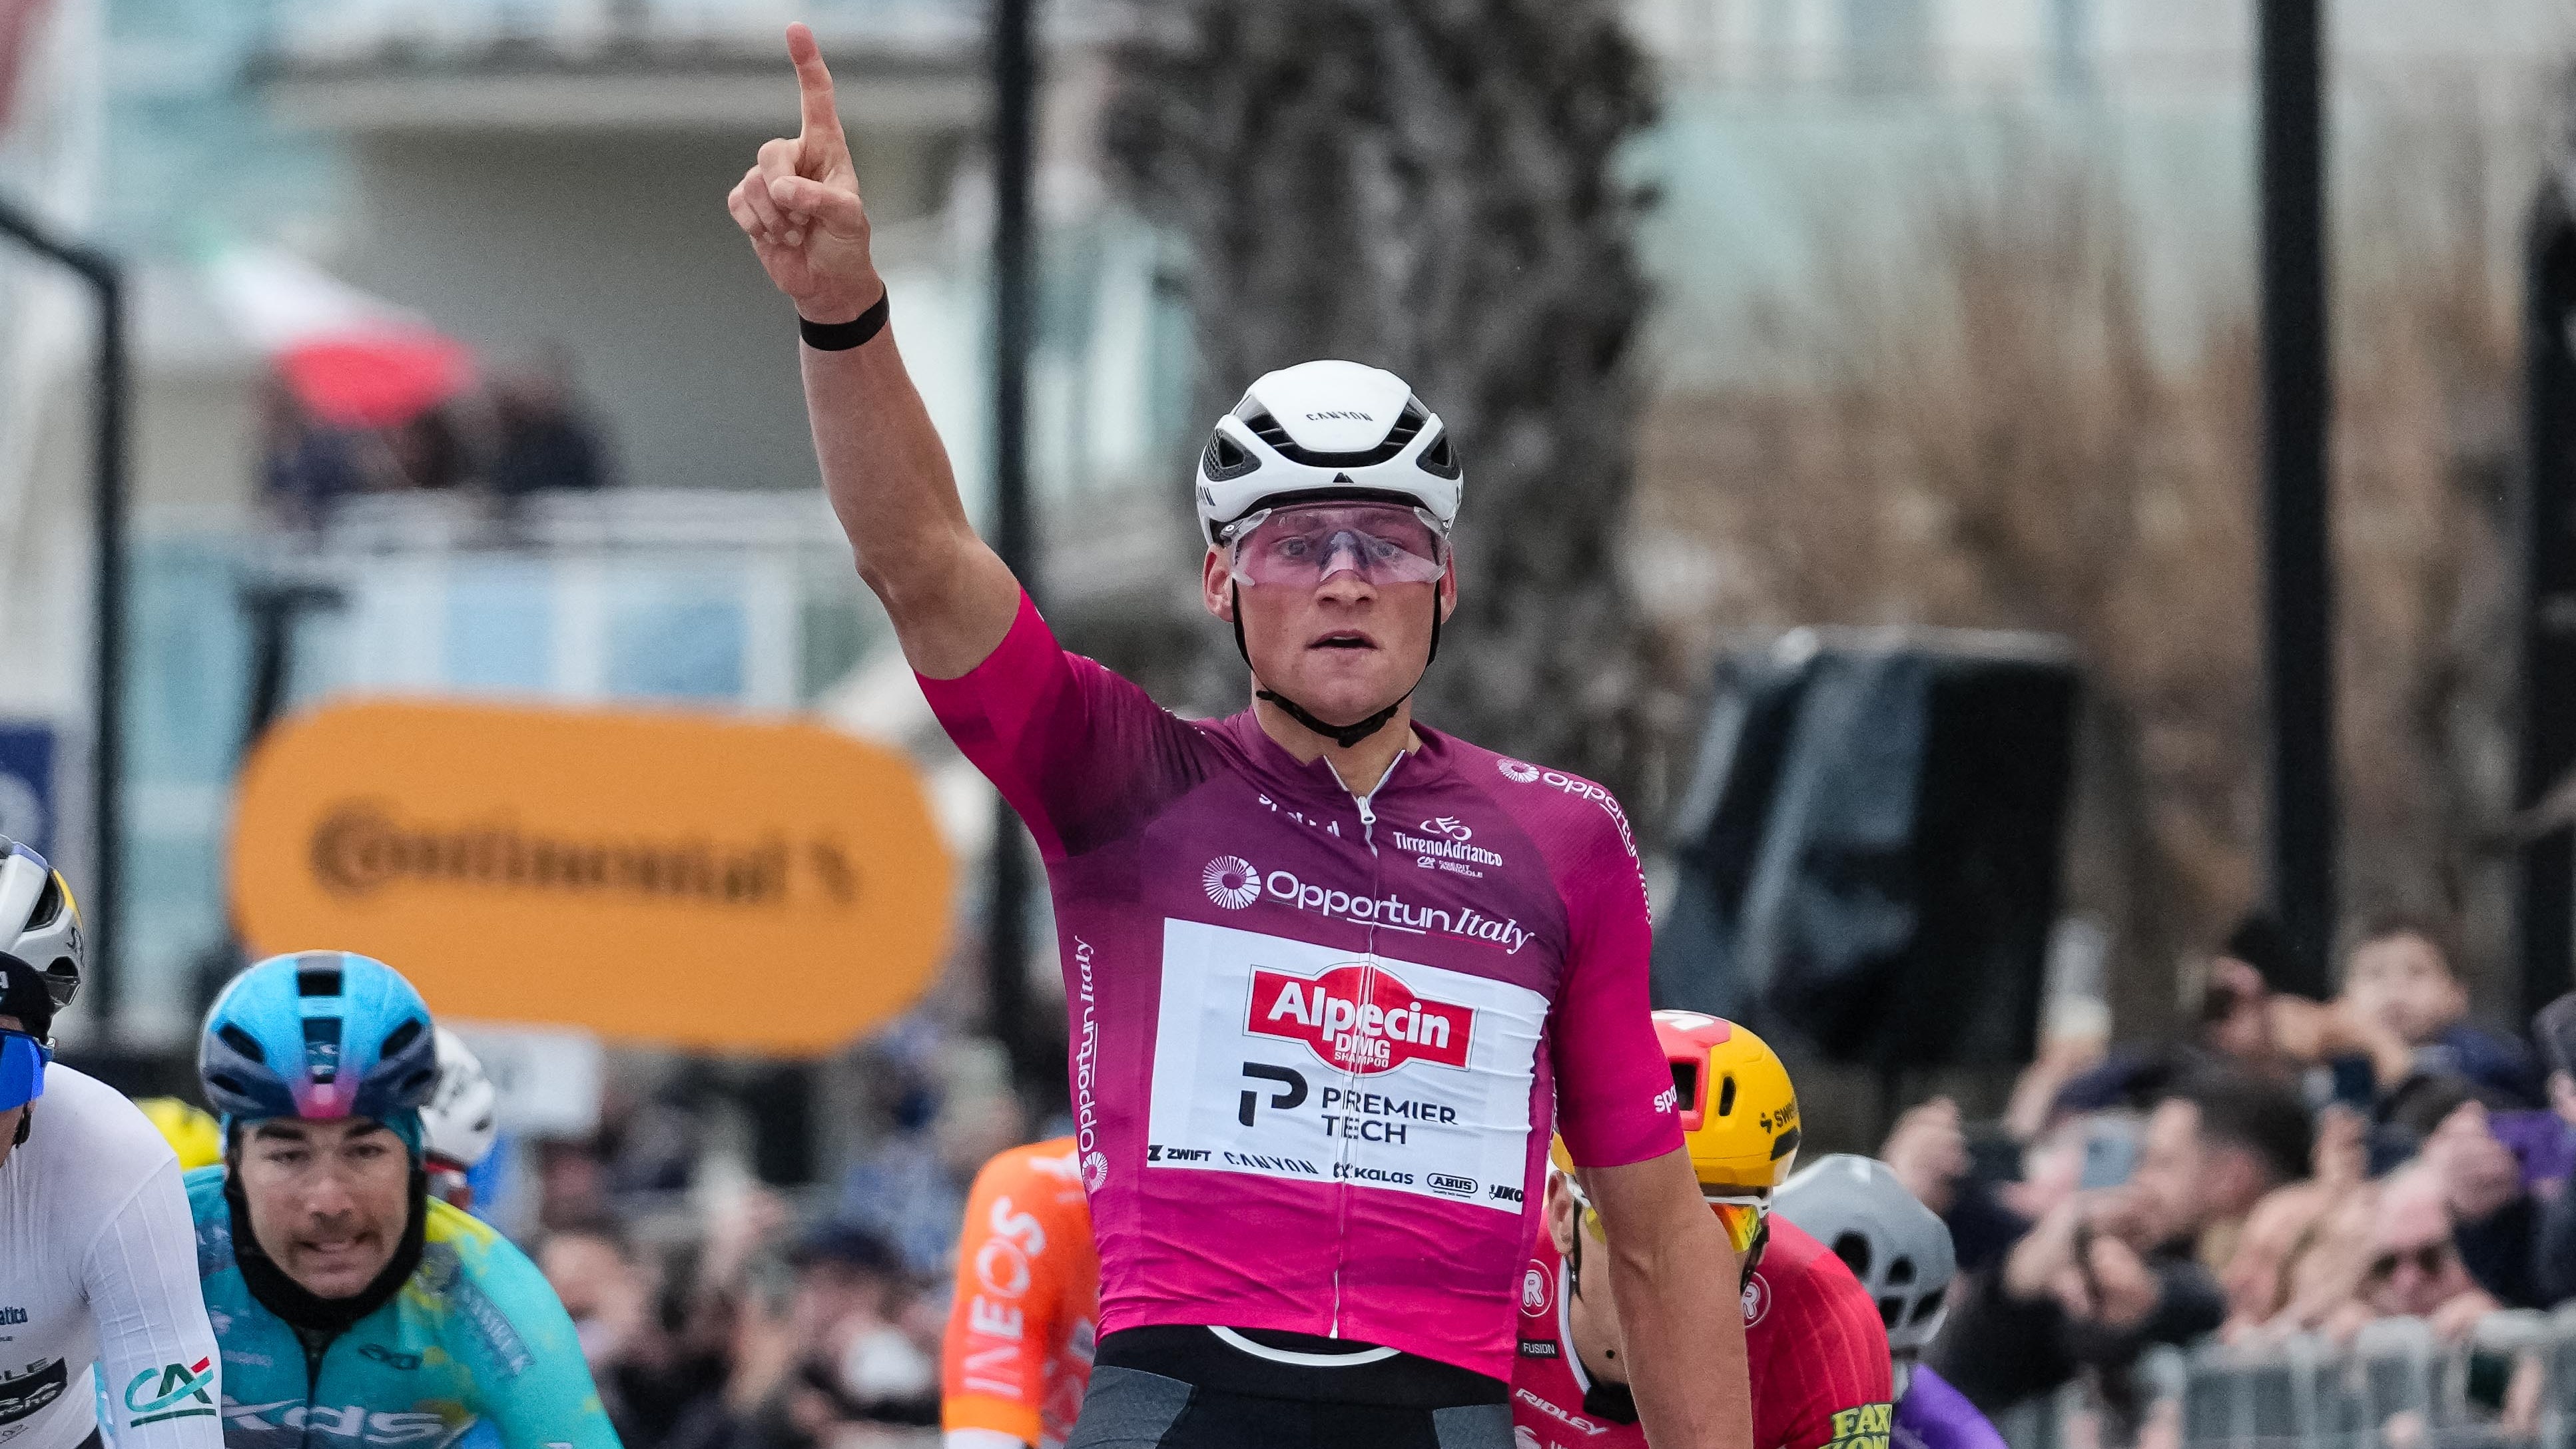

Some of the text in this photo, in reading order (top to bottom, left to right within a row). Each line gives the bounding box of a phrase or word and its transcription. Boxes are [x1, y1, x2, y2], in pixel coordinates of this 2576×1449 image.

[1306, 411, 1373, 422] CANYON
[1266, 871, 1535, 955] OpportunItaly
[1267, 981, 1450, 1049] Alpecin
[1074, 935, 1097, 1152] OpportunItaly
[1335, 1033, 1391, 1059] DMG
[1334, 1051, 1389, 1067] SHAMPOO
[1322, 1086, 1458, 1125] PREMIER
[1321, 1114, 1407, 1145] TECH
[1167, 1148, 1212, 1161] ZWIFT
[1223, 1151, 1319, 1175] CANYON
[1433, 1176, 1472, 1191] ABUS
[963, 1196, 1046, 1399] INEOS
[1523, 1342, 1555, 1354] FUSION
[1515, 1388, 1610, 1435] RIDLEY
